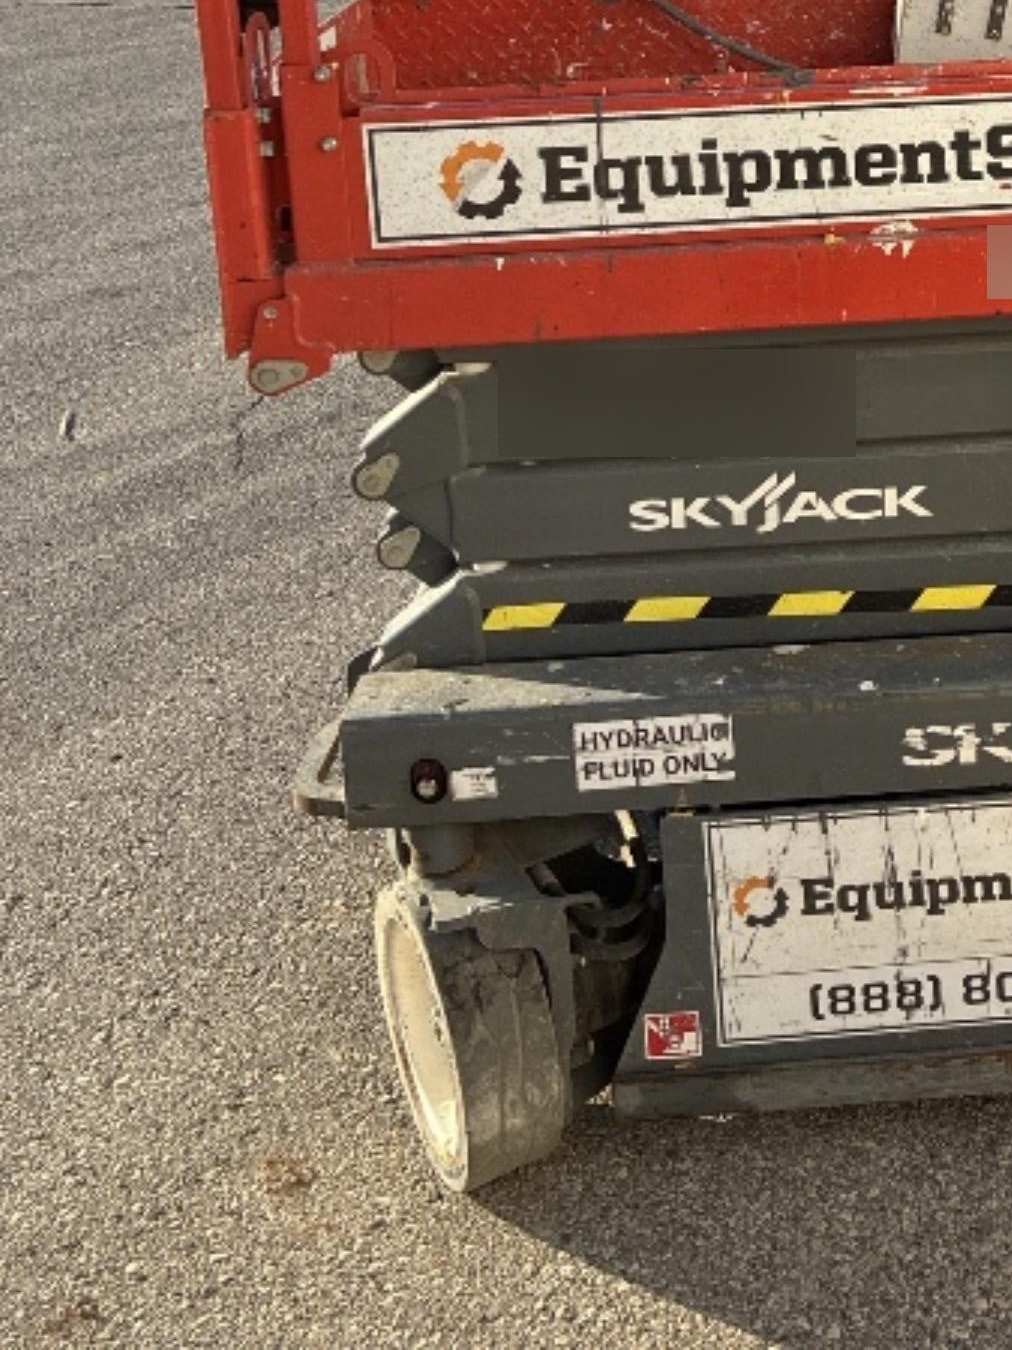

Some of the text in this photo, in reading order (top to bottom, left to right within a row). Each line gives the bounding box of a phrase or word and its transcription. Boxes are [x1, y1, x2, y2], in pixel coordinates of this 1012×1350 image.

[628, 470, 935, 534] SKYJACK
[579, 721, 730, 751] HYDRAULIC
[583, 751, 727, 781] FLUID ONLY
[809, 974, 942, 1022] (888)
